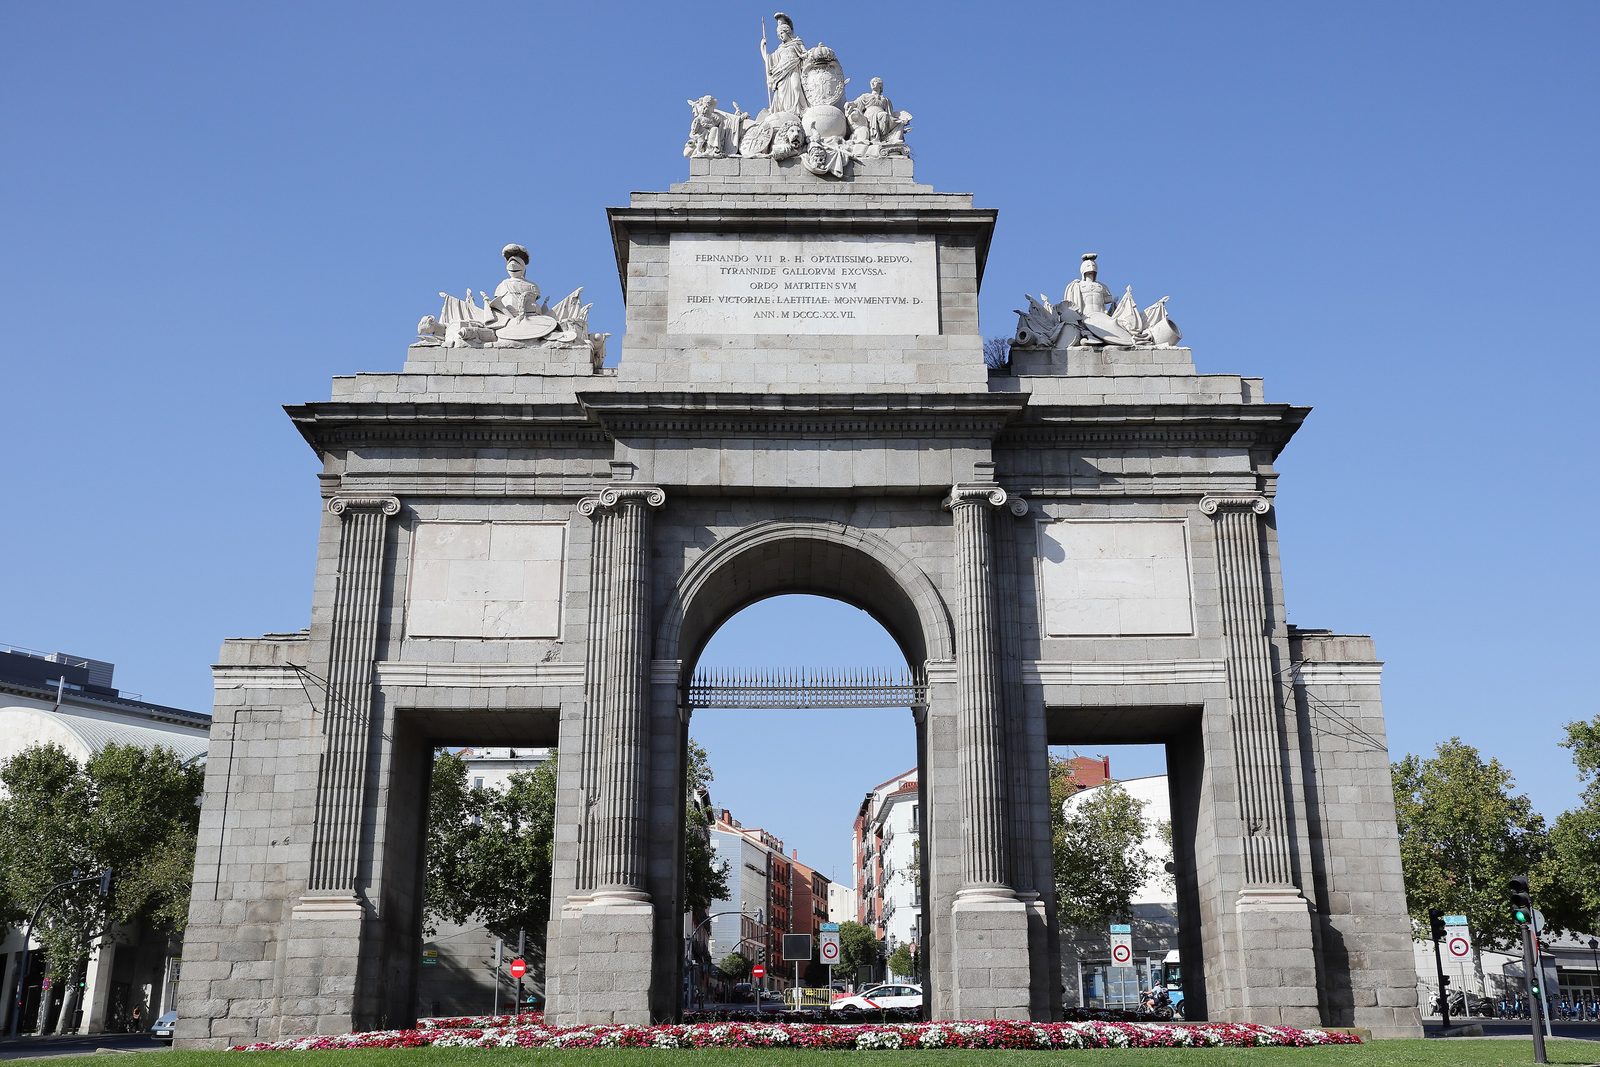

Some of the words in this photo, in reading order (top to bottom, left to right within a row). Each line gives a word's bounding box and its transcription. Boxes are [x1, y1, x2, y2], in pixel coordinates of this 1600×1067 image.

[695, 254, 749, 263] FERNANDO
[755, 255, 772, 263] VII
[720, 267, 777, 275] TYRANNIDE
[782, 267, 836, 275] GALLORVM
[749, 281, 779, 290] ORDO
